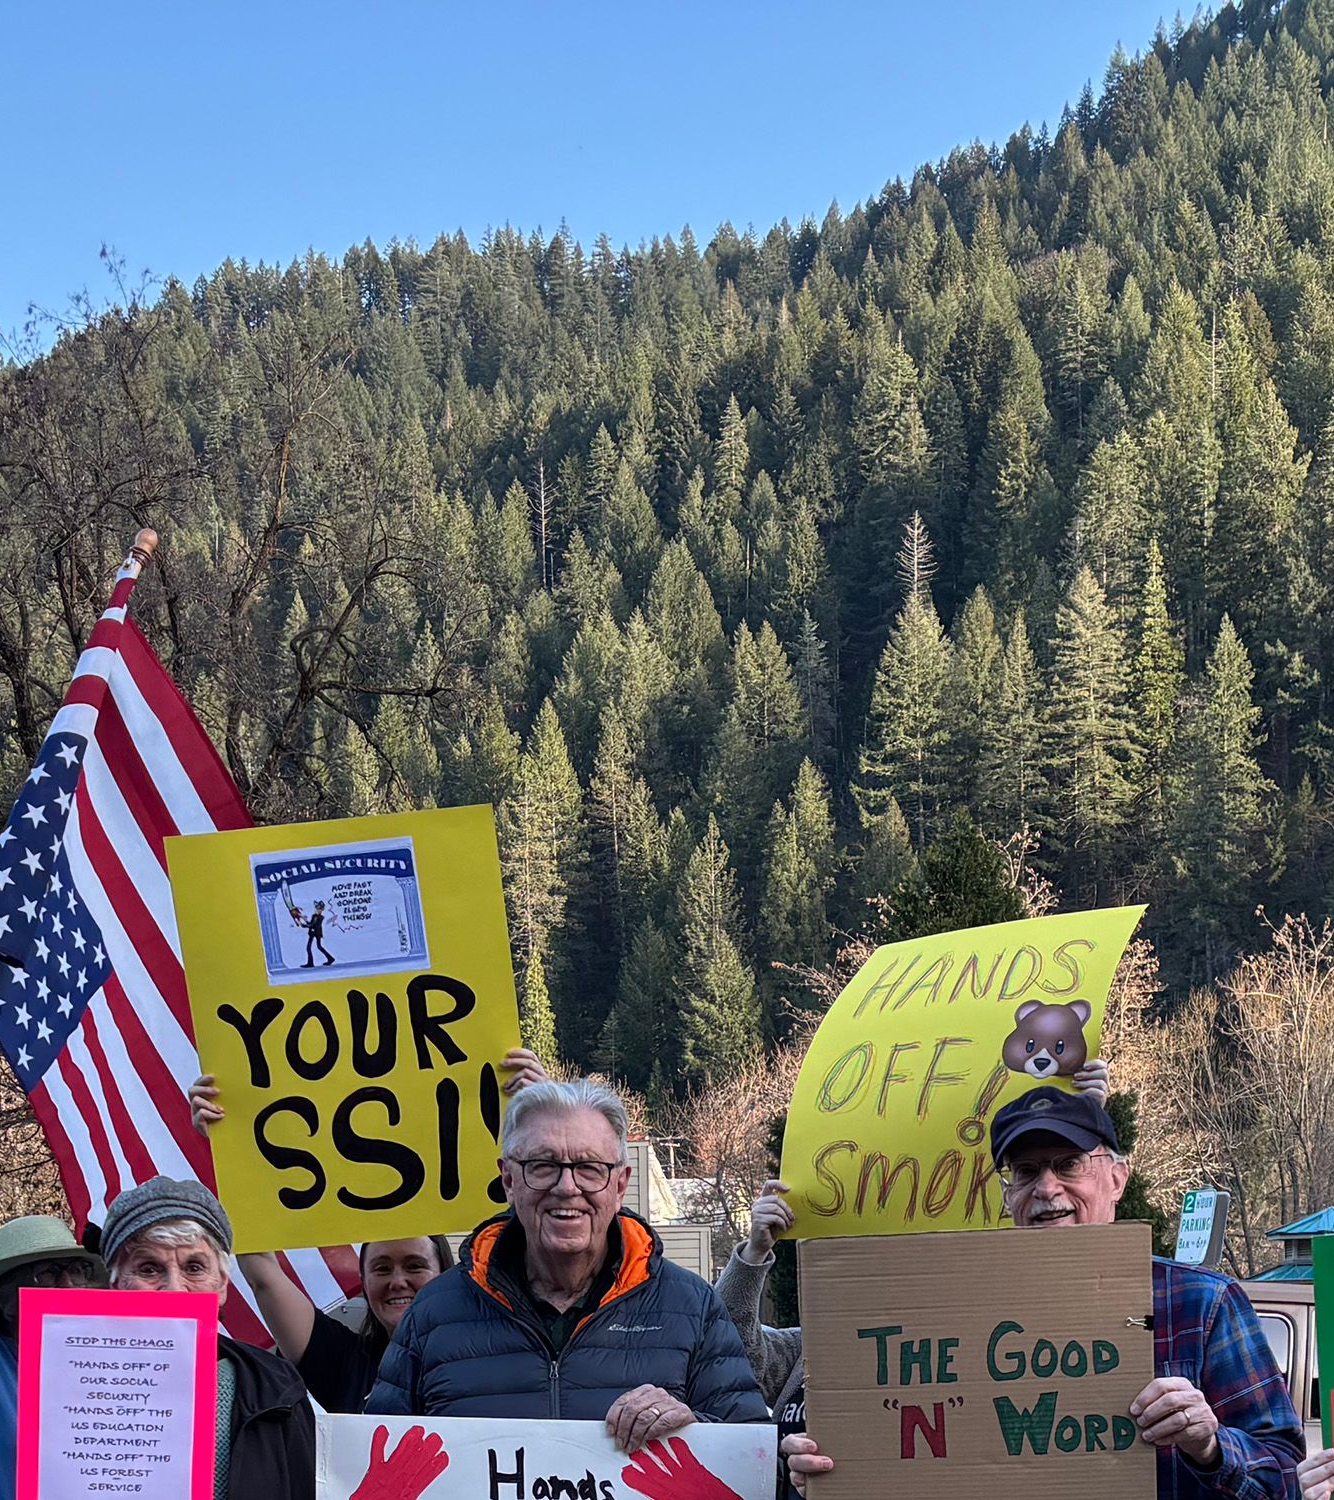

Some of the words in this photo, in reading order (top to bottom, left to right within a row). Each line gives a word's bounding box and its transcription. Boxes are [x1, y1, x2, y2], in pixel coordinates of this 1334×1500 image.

[259, 863, 321, 886] SOCIAL
[324, 858, 409, 871] SECURITY
[853, 939, 1097, 1020] HANDS
[217, 974, 476, 1088] YOUR
[816, 1037, 1010, 1147] OFF!
[253, 1062, 508, 1211] SSI!
[805, 1140, 1013, 1227] SMOK
[1185, 1195, 1194, 1211] 2
[1180, 1217, 1211, 1232] PARKING
[65, 1336, 100, 1344] STOP
[102, 1338, 127, 1346] THE
[129, 1338, 175, 1348] CHAOS
[857, 1326, 960, 1386] THE
[987, 1321, 1120, 1381] GOOD
[69, 1360, 118, 1370] "HANDS
[122, 1362, 151, 1371] OFF"
[153, 1363, 170, 1372] OF
[80, 1376, 108, 1385] OUR
[110, 1377, 159, 1386] SOCIAL
[86, 1391, 151, 1405] SECURITY
[63, 1406, 114, 1415] "HANDS
[147, 1409, 173, 1418] THE
[71, 1422, 89, 1430] US
[92, 1423, 164, 1432] EDUCATION
[883, 1396, 965, 1459] "N"
[992, 1391, 1136, 1456] WORD
[74, 1437, 161, 1447] DEPARTMENT
[62, 1451, 112, 1461] "HANDS
[114, 1453, 144, 1462] OFF"
[146, 1454, 171, 1463] THE
[80, 1468, 99, 1476] US
[101, 1468, 154, 1477] FOREST
[87, 1483, 144, 1492] SERVICE
